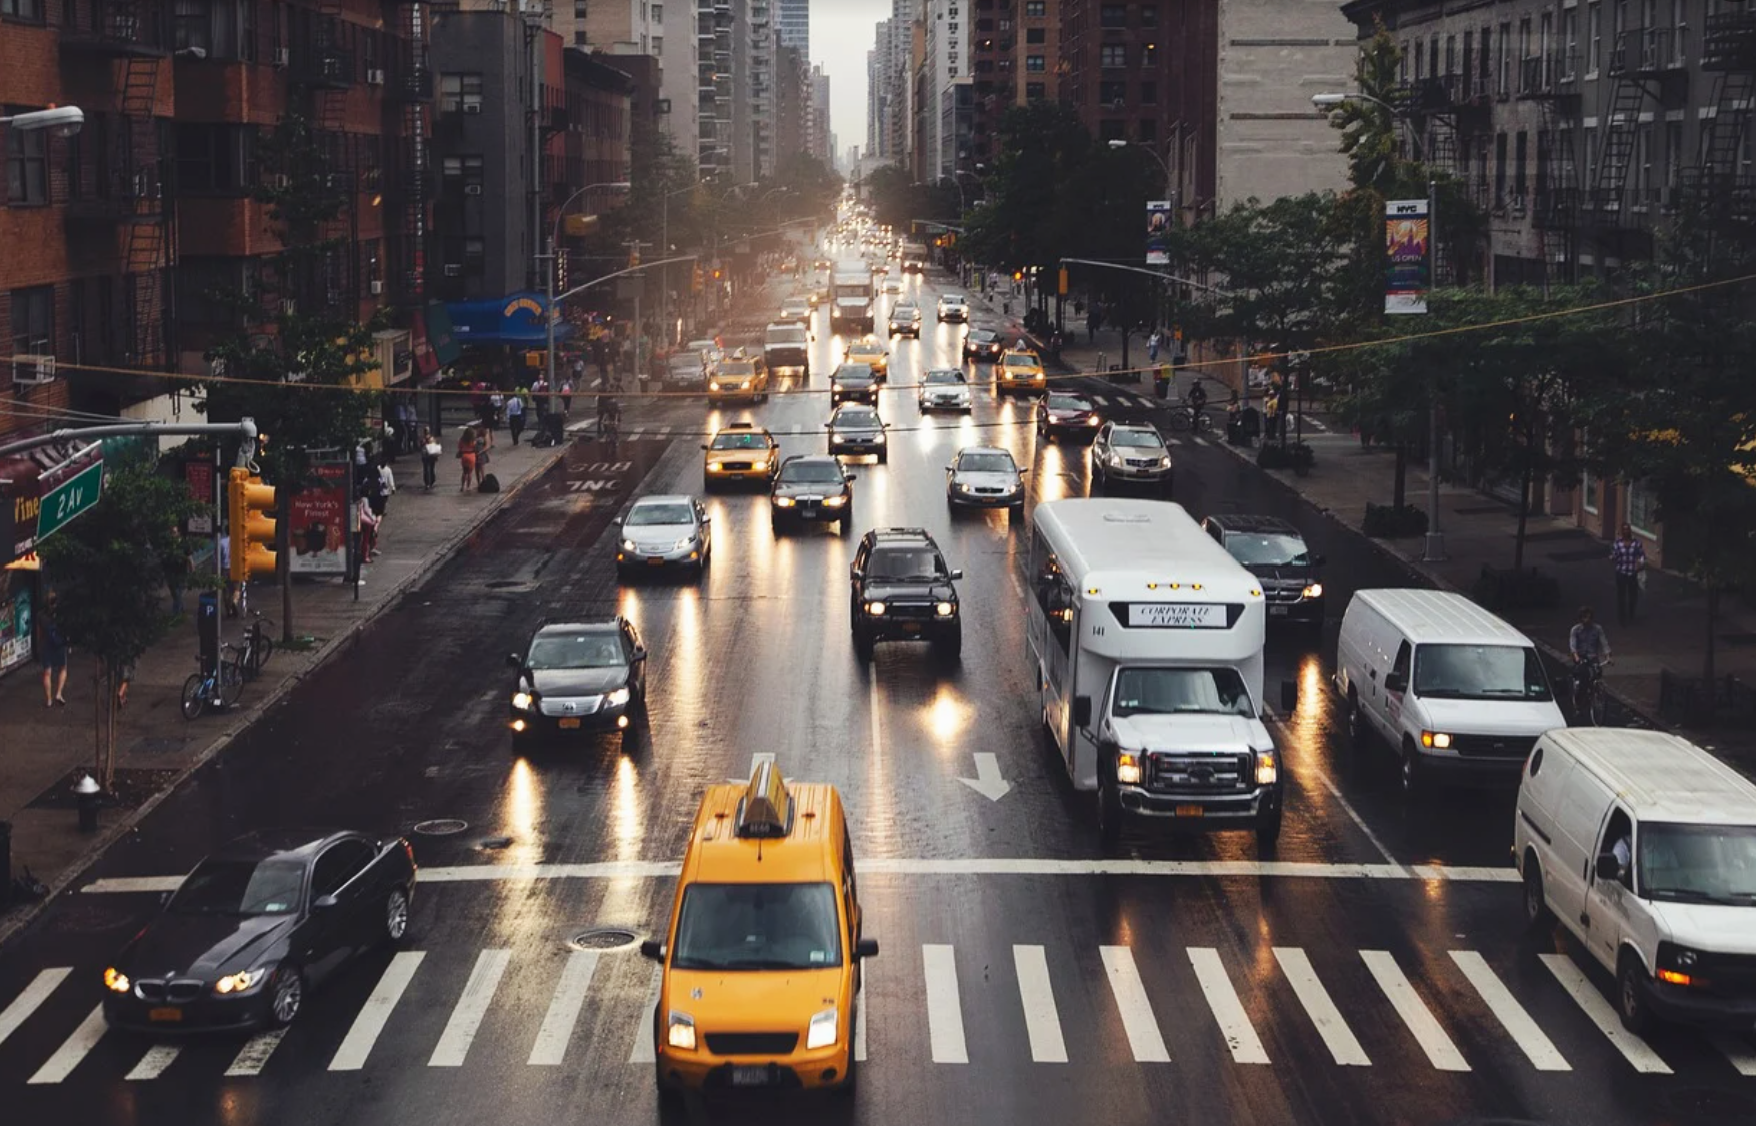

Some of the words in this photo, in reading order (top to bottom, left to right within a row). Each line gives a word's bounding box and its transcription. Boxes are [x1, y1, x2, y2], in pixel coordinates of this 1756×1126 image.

[1396, 205, 1417, 213] NYC
[567, 461, 633, 473] BUS
[57, 493, 66, 520] 2
[66, 486, 83, 514] Av
[295, 500, 312, 509] New
[314, 500, 339, 509] York's
[206, 604, 214, 616] P
[1141, 607, 1211, 615] CORPORATE
[1151, 616, 1203, 624] EXPRESS
[1092, 626, 1105, 636] 141
